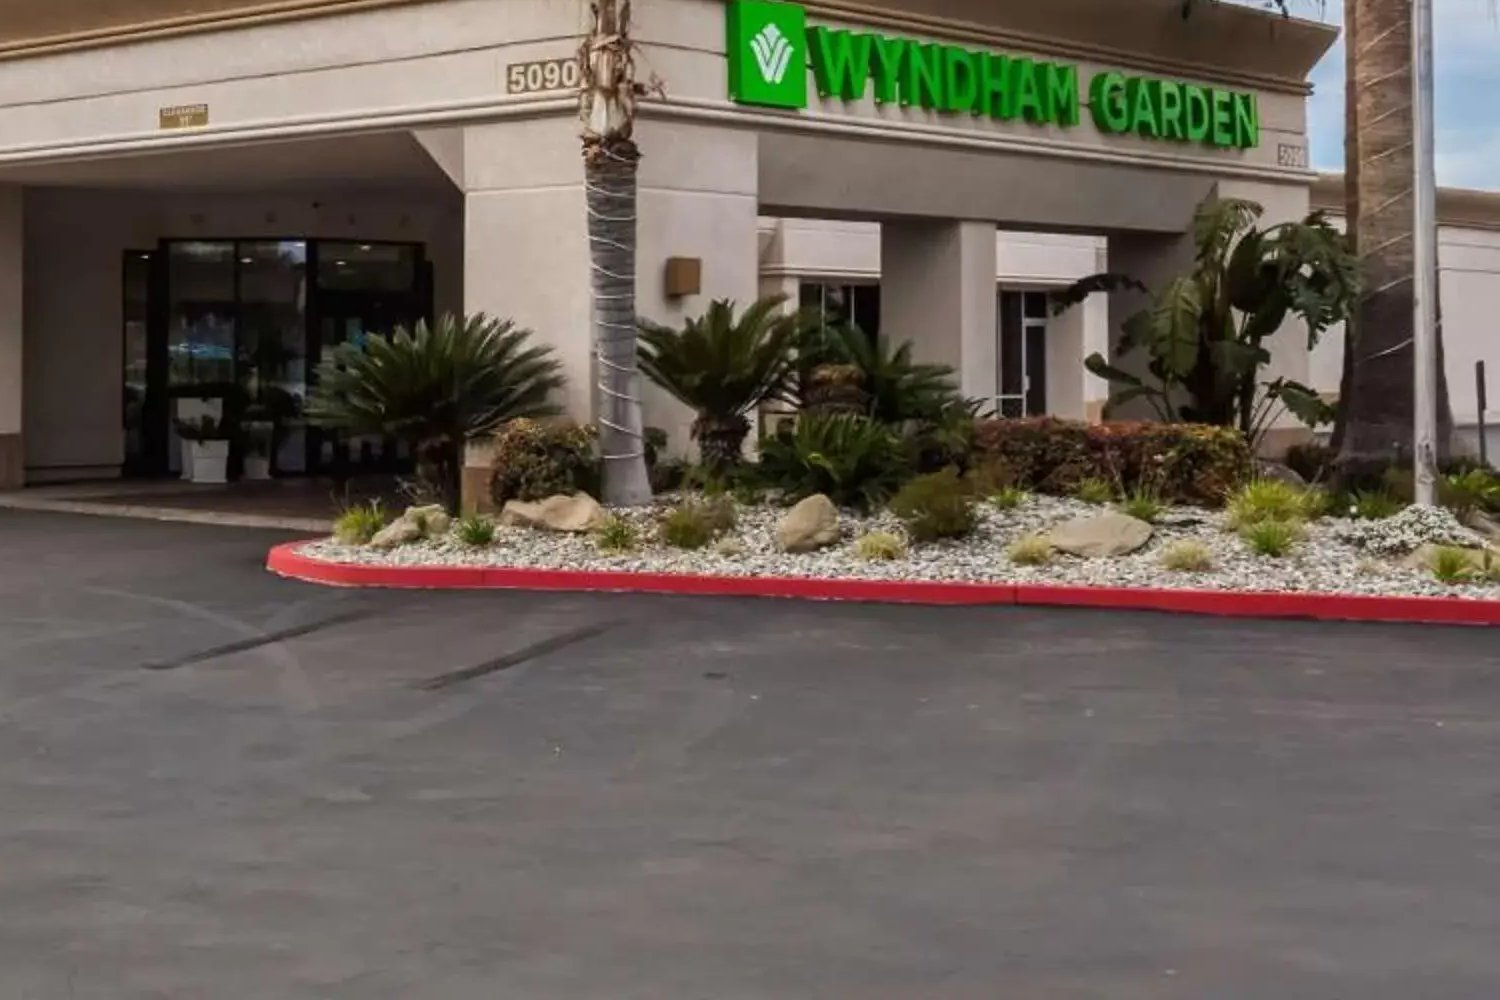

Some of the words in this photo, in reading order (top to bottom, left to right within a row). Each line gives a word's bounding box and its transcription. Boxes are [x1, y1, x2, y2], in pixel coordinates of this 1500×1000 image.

[509, 60, 578, 92] 5090
[804, 25, 1080, 127] WYNDHAM
[1088, 71, 1259, 149] GARDEN
